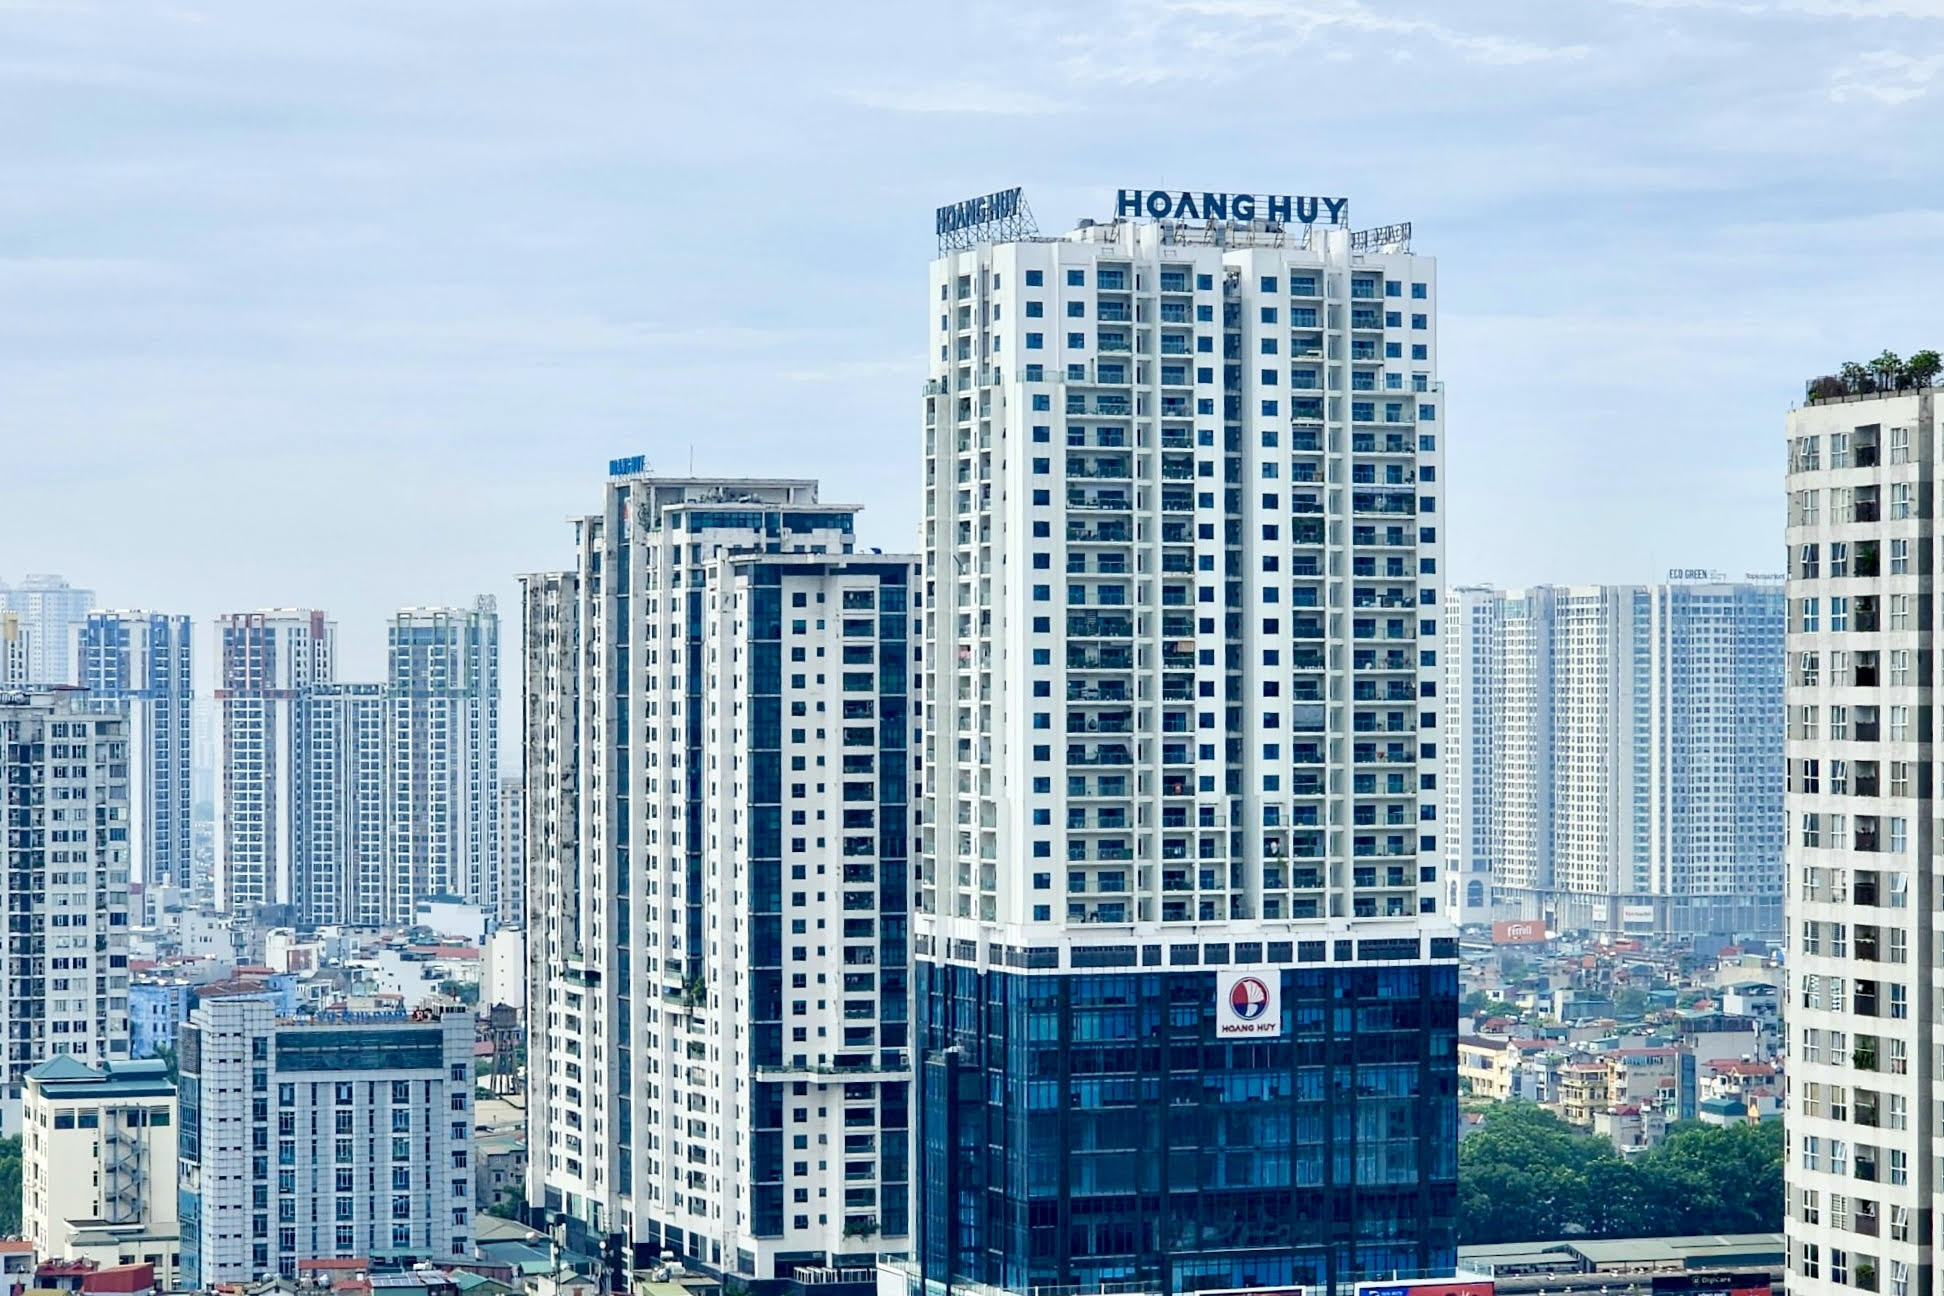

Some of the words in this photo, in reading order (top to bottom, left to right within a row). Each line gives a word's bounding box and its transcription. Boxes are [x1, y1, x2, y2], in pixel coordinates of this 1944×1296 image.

[936, 196, 985, 234] HOANG
[988, 187, 1021, 221] HUY
[1118, 189, 1255, 221] HOANG
[1268, 195, 1348, 224] HUY
[1669, 569, 1683, 579] ECO
[1685, 569, 1707, 579] GREEN
[1257, 1023, 1276, 1031] HUY
